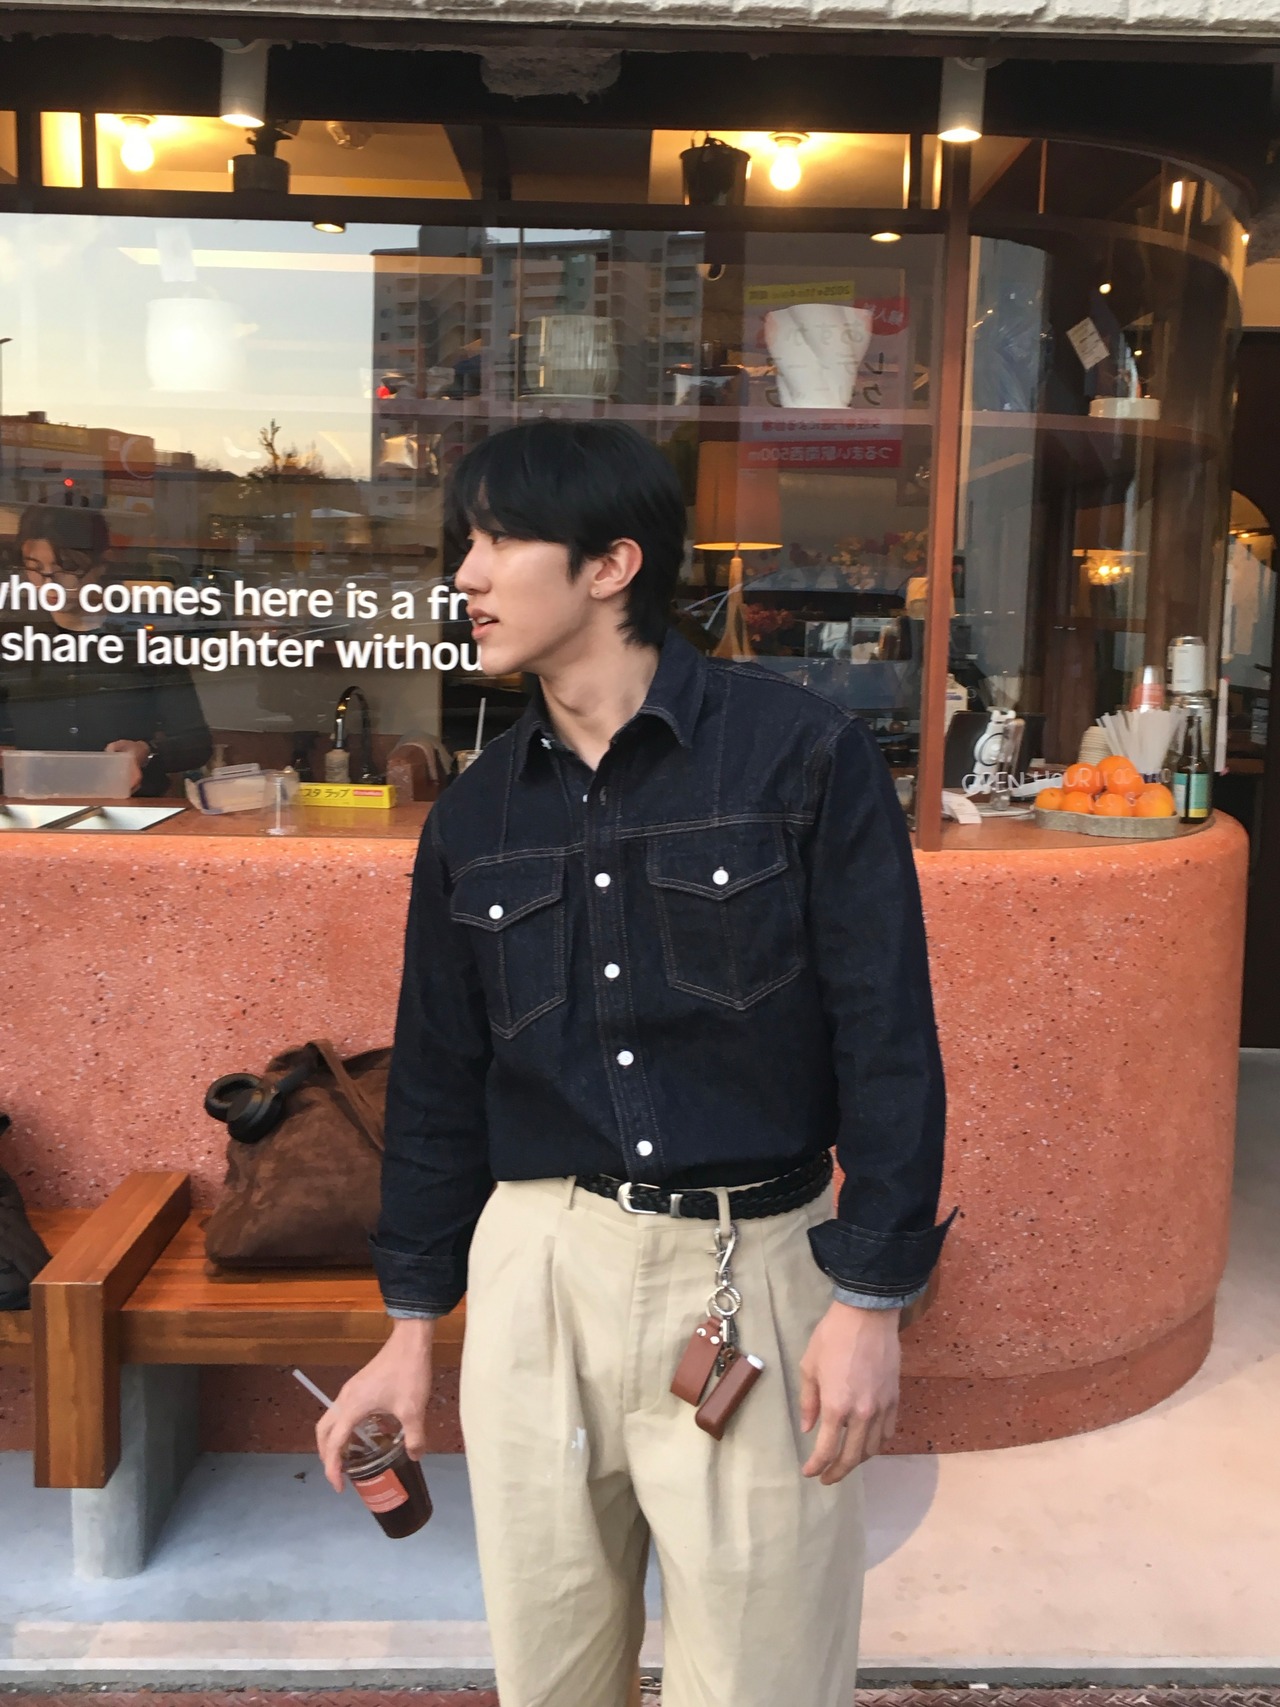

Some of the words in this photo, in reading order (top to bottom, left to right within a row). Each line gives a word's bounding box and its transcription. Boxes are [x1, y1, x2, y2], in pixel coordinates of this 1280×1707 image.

[0, 575, 66, 611] ho
[79, 583, 221, 615] comes
[235, 580, 333, 618] here
[347, 583, 378, 619] is
[391, 590, 414, 620] a
[1, 626, 124, 663] share
[137, 628, 324, 672] laughter
[335, 633, 482, 670] withou
